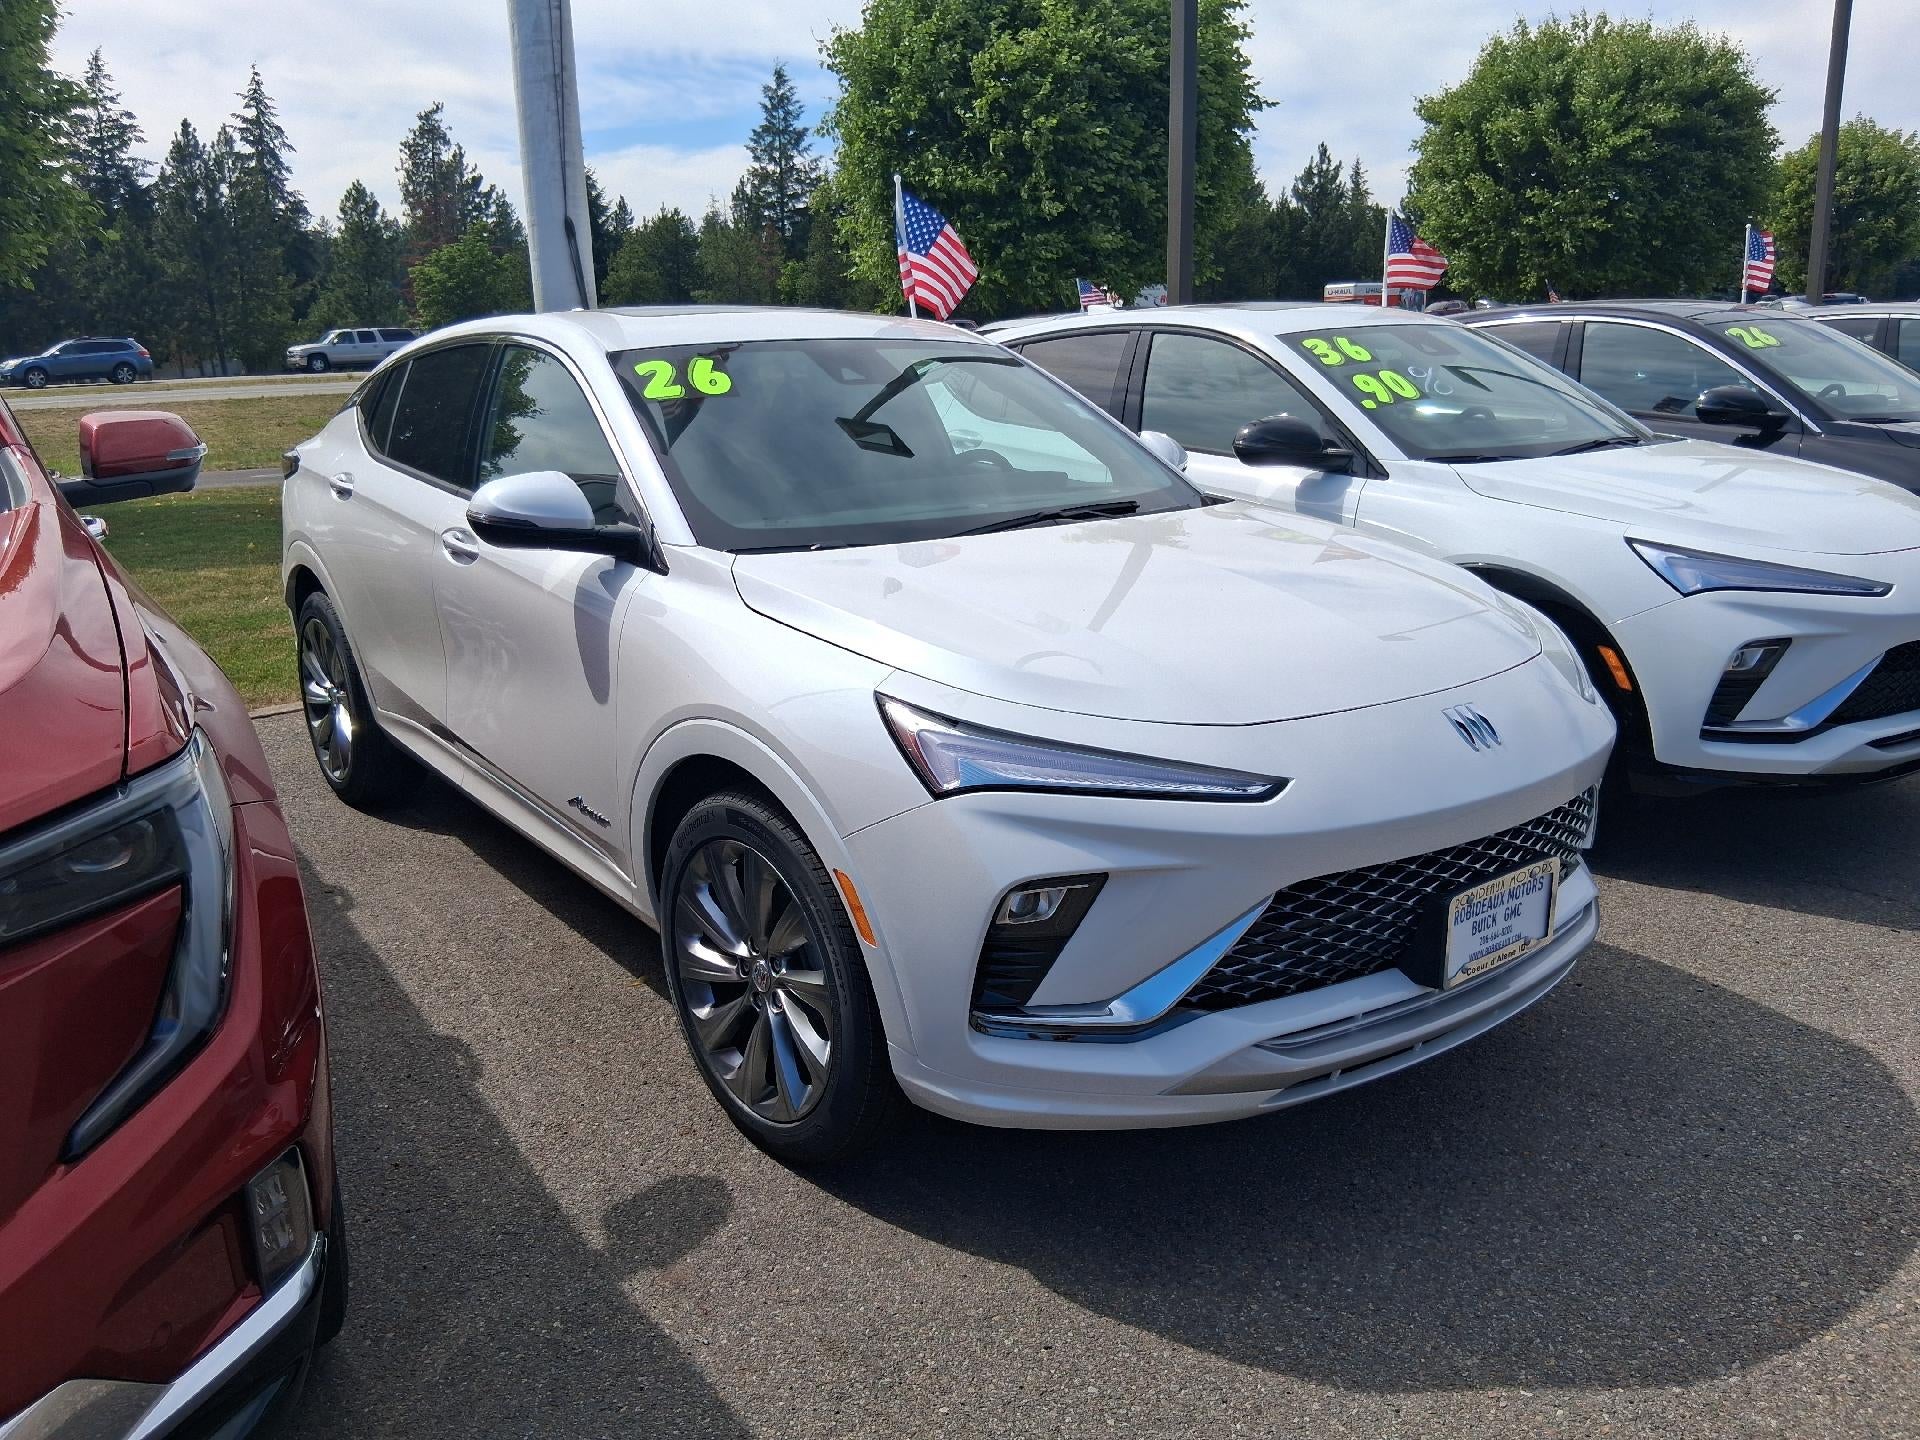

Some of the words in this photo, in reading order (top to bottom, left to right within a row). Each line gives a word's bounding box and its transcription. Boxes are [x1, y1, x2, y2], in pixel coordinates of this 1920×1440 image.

[1327, 288, 1353, 296] U-HAUL
[1302, 336, 1373, 366] 36
[1725, 326, 1780, 348] 26
[634, 356, 733, 400] 26
[1454, 890, 1506, 926] ROBIDEAUX
[1507, 876, 1545, 903] MOTORS
[1471, 913, 1497, 936] BUICK
[1504, 903, 1523, 921] GMC
[1466, 962, 1489, 977] Coeur
